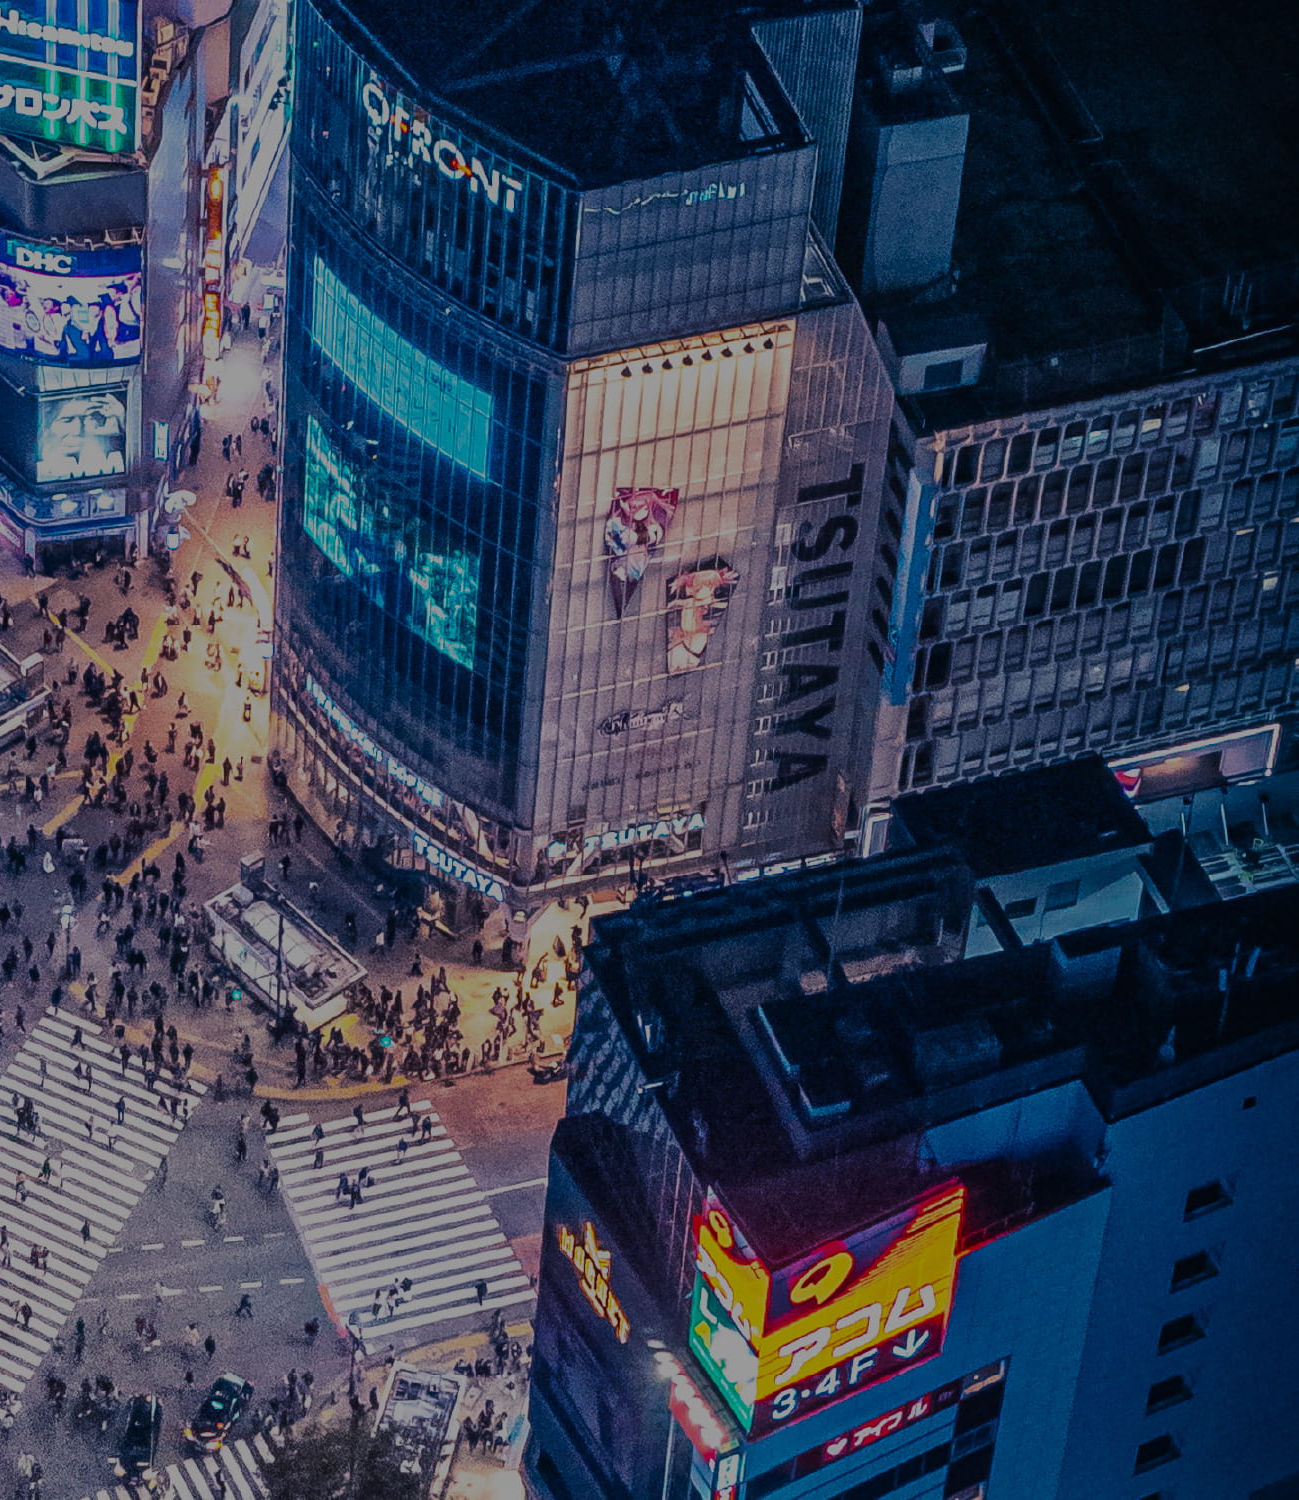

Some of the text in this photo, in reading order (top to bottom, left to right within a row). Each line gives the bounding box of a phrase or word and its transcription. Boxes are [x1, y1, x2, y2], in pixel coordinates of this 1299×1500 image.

[362, 83, 523, 213] QFRONT
[16, 246, 72, 274] DHC
[772, 462, 866, 794] TSUTAYA
[413, 835, 504, 902] TSUTAYA
[583, 813, 705, 851] TSUTAYA
[774, 1284, 936, 1384] アコム
